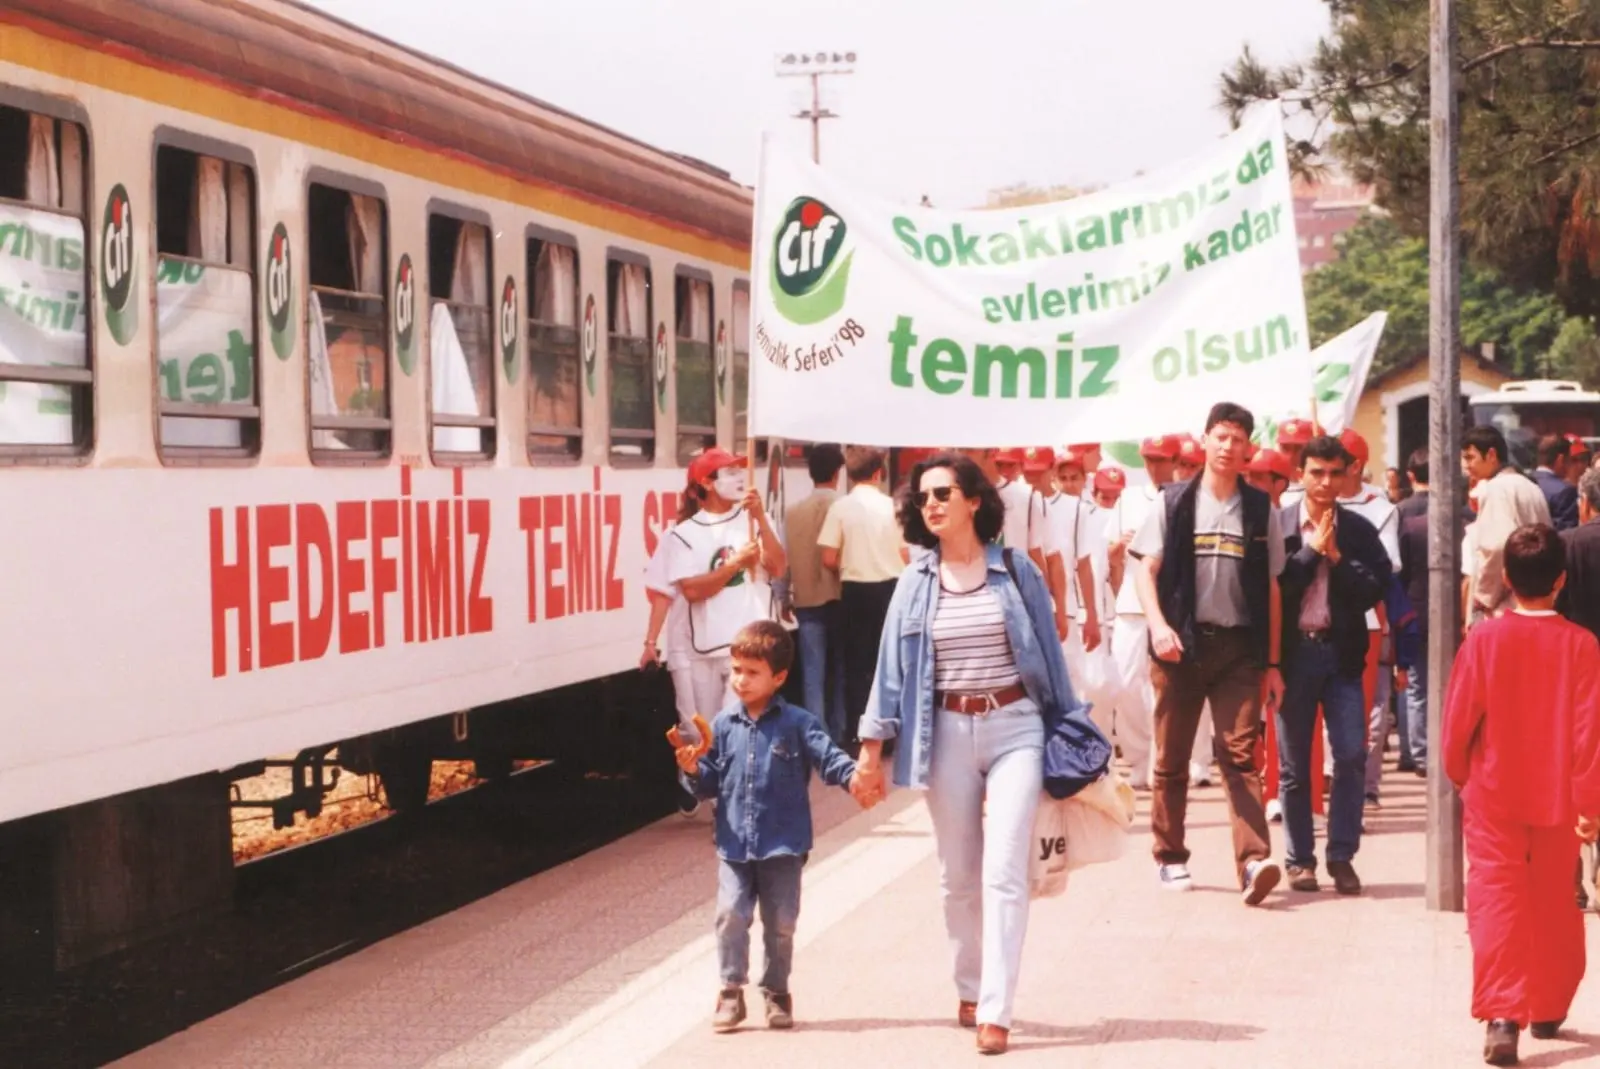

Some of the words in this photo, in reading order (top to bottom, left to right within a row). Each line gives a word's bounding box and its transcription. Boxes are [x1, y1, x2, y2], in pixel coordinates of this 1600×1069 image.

[892, 170, 1231, 268] Sokaklarımız
[1236, 140, 1274, 185] da
[981, 260, 1171, 324] evlerimiz
[1183, 202, 1282, 272] kadar
[888, 315, 1121, 400] temiz
[209, 464, 494, 679] HEDEFİMİZ
[519, 465, 624, 624] TEMİZ
